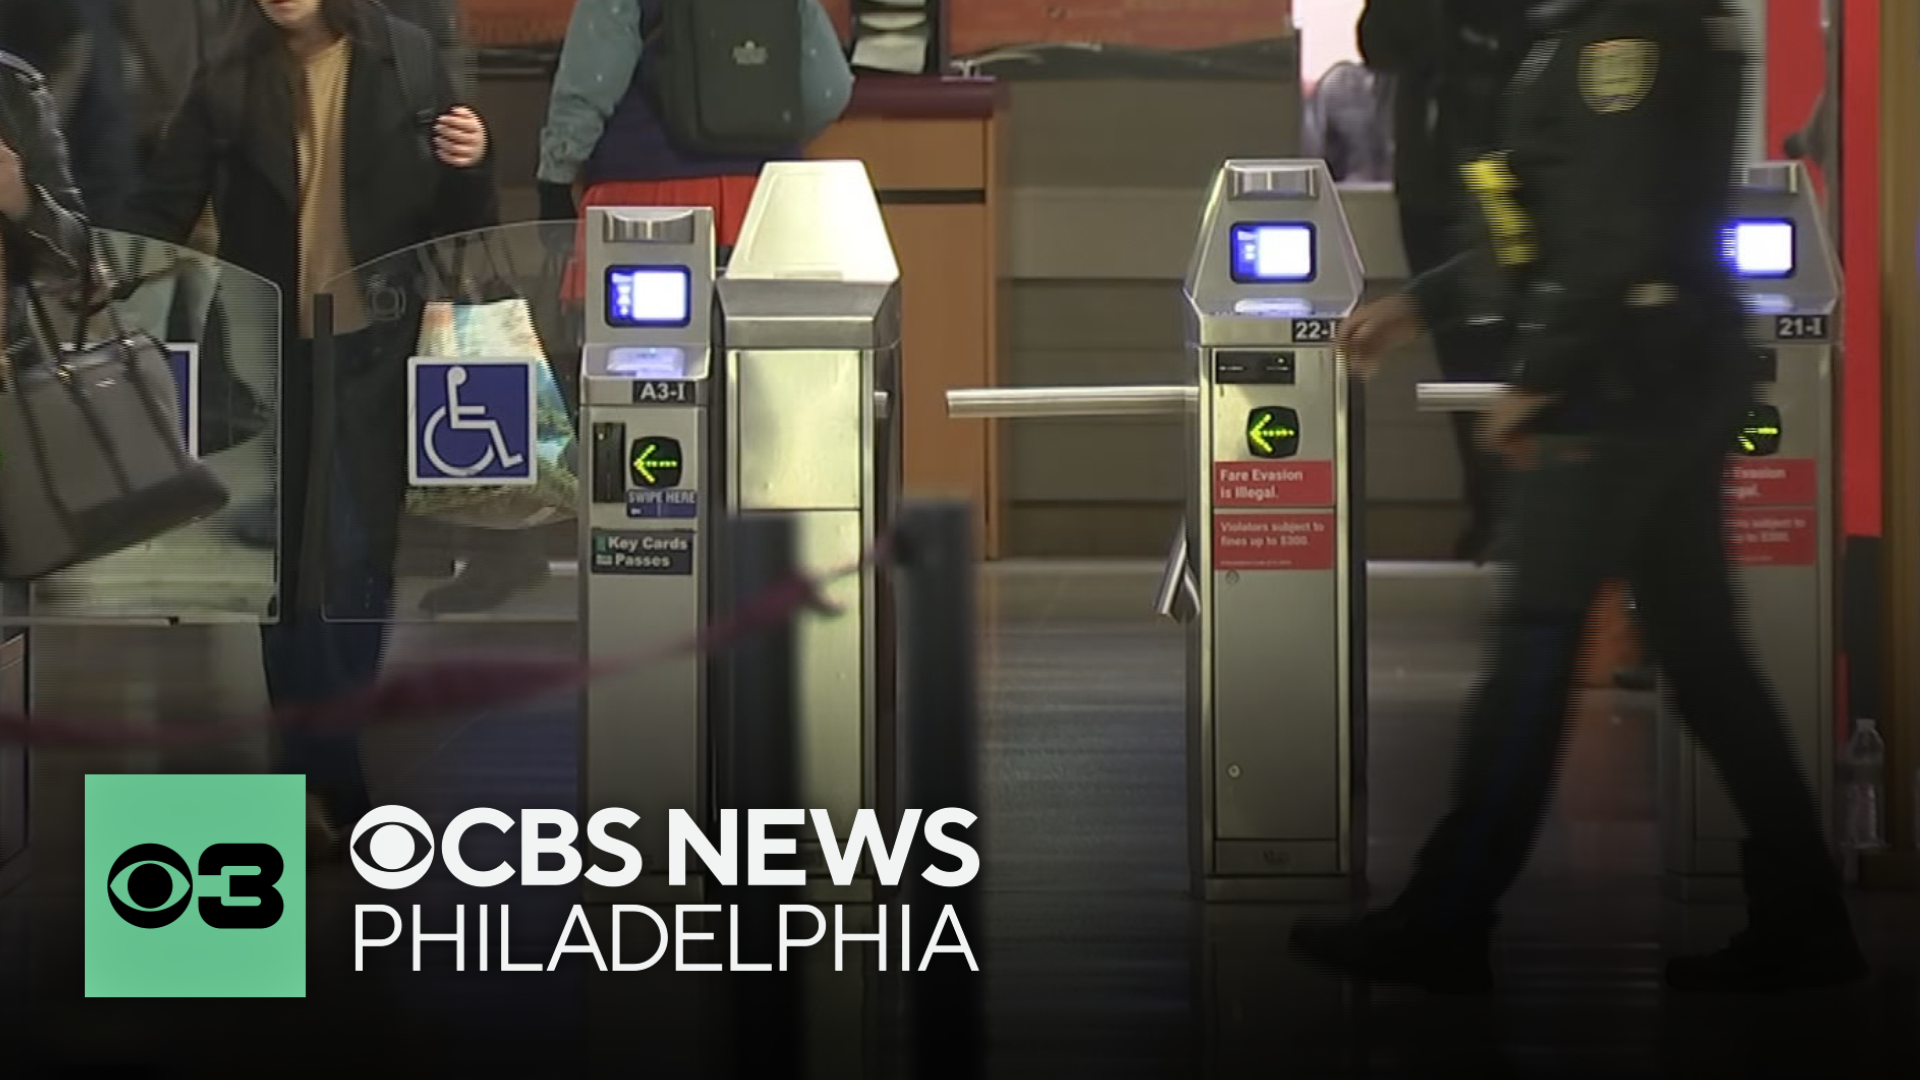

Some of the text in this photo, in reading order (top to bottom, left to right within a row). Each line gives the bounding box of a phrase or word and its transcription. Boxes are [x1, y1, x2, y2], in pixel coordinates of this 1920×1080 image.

[1779, 317, 1822, 336] 21-I
[640, 382, 686, 400] A3-I
[1220, 468, 1304, 481] Fare Evasion
[628, 491, 696, 504] SWIPE HERE
[1221, 485, 1279, 501] is Illegal.
[1220, 522, 1325, 534] Violators subject to
[607, 536, 688, 553] Key Cards
[1220, 536, 1248, 546] fines
[1249, 538, 1264, 548] up
[1266, 536, 1278, 546] to
[615, 553, 671, 568] Passes
